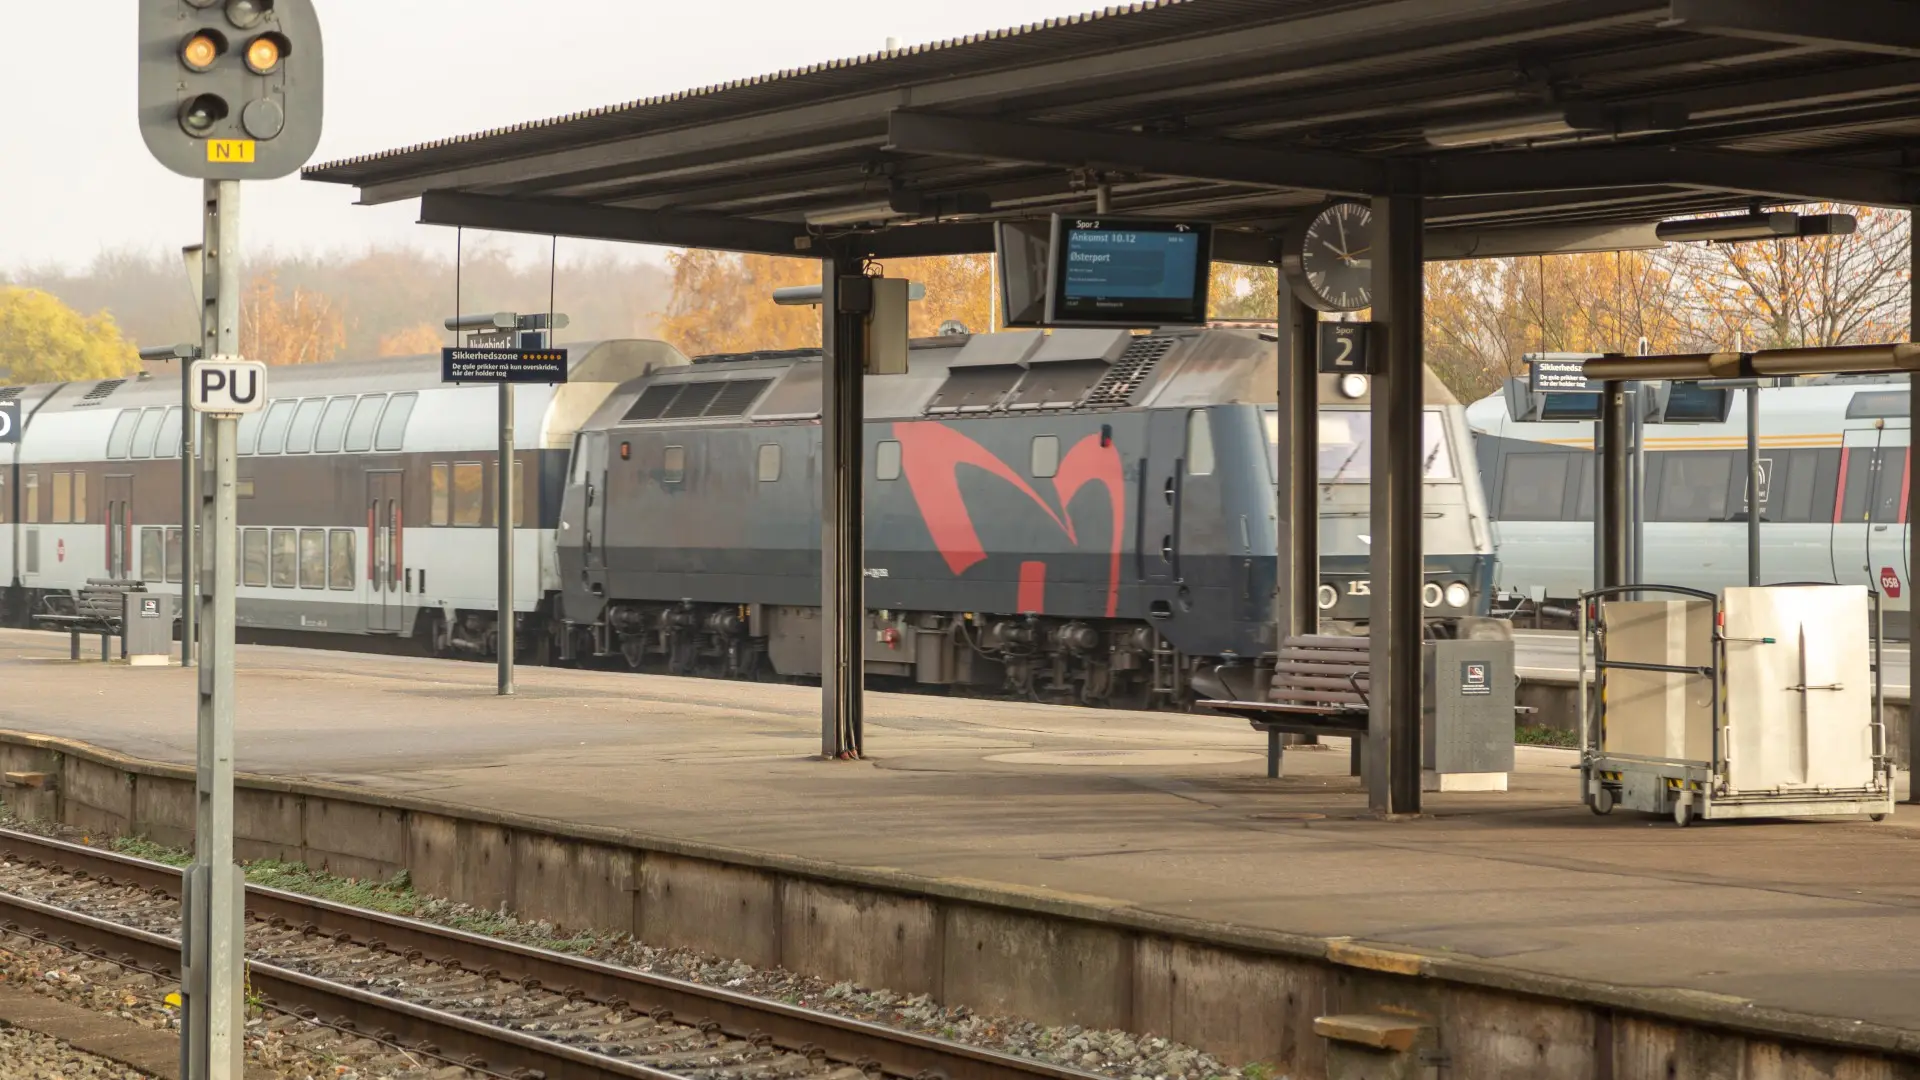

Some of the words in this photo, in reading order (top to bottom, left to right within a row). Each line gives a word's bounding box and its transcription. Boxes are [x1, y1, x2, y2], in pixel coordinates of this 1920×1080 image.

[216, 143, 230, 159] N
[238, 142, 244, 159] 1
[1076, 220, 1093, 230] Spor
[1094, 221, 1100, 229] 2
[1071, 232, 1109, 242] Ankomst
[1112, 233, 1136, 243] 10.12
[1070, 251, 1111, 263] Østerport
[1336, 326, 1354, 336] Spor
[452, 351, 518, 361] Sikkerhedszone
[1336, 337, 1353, 366] 2
[476, 363, 499, 371] prikker
[523, 364, 560, 372] overskrides,
[1539, 363, 1584, 372] Sikkerhedsz
[496, 371, 507, 379] tog
[201, 369, 257, 405] PU
[1882, 577, 1899, 589] DSB
